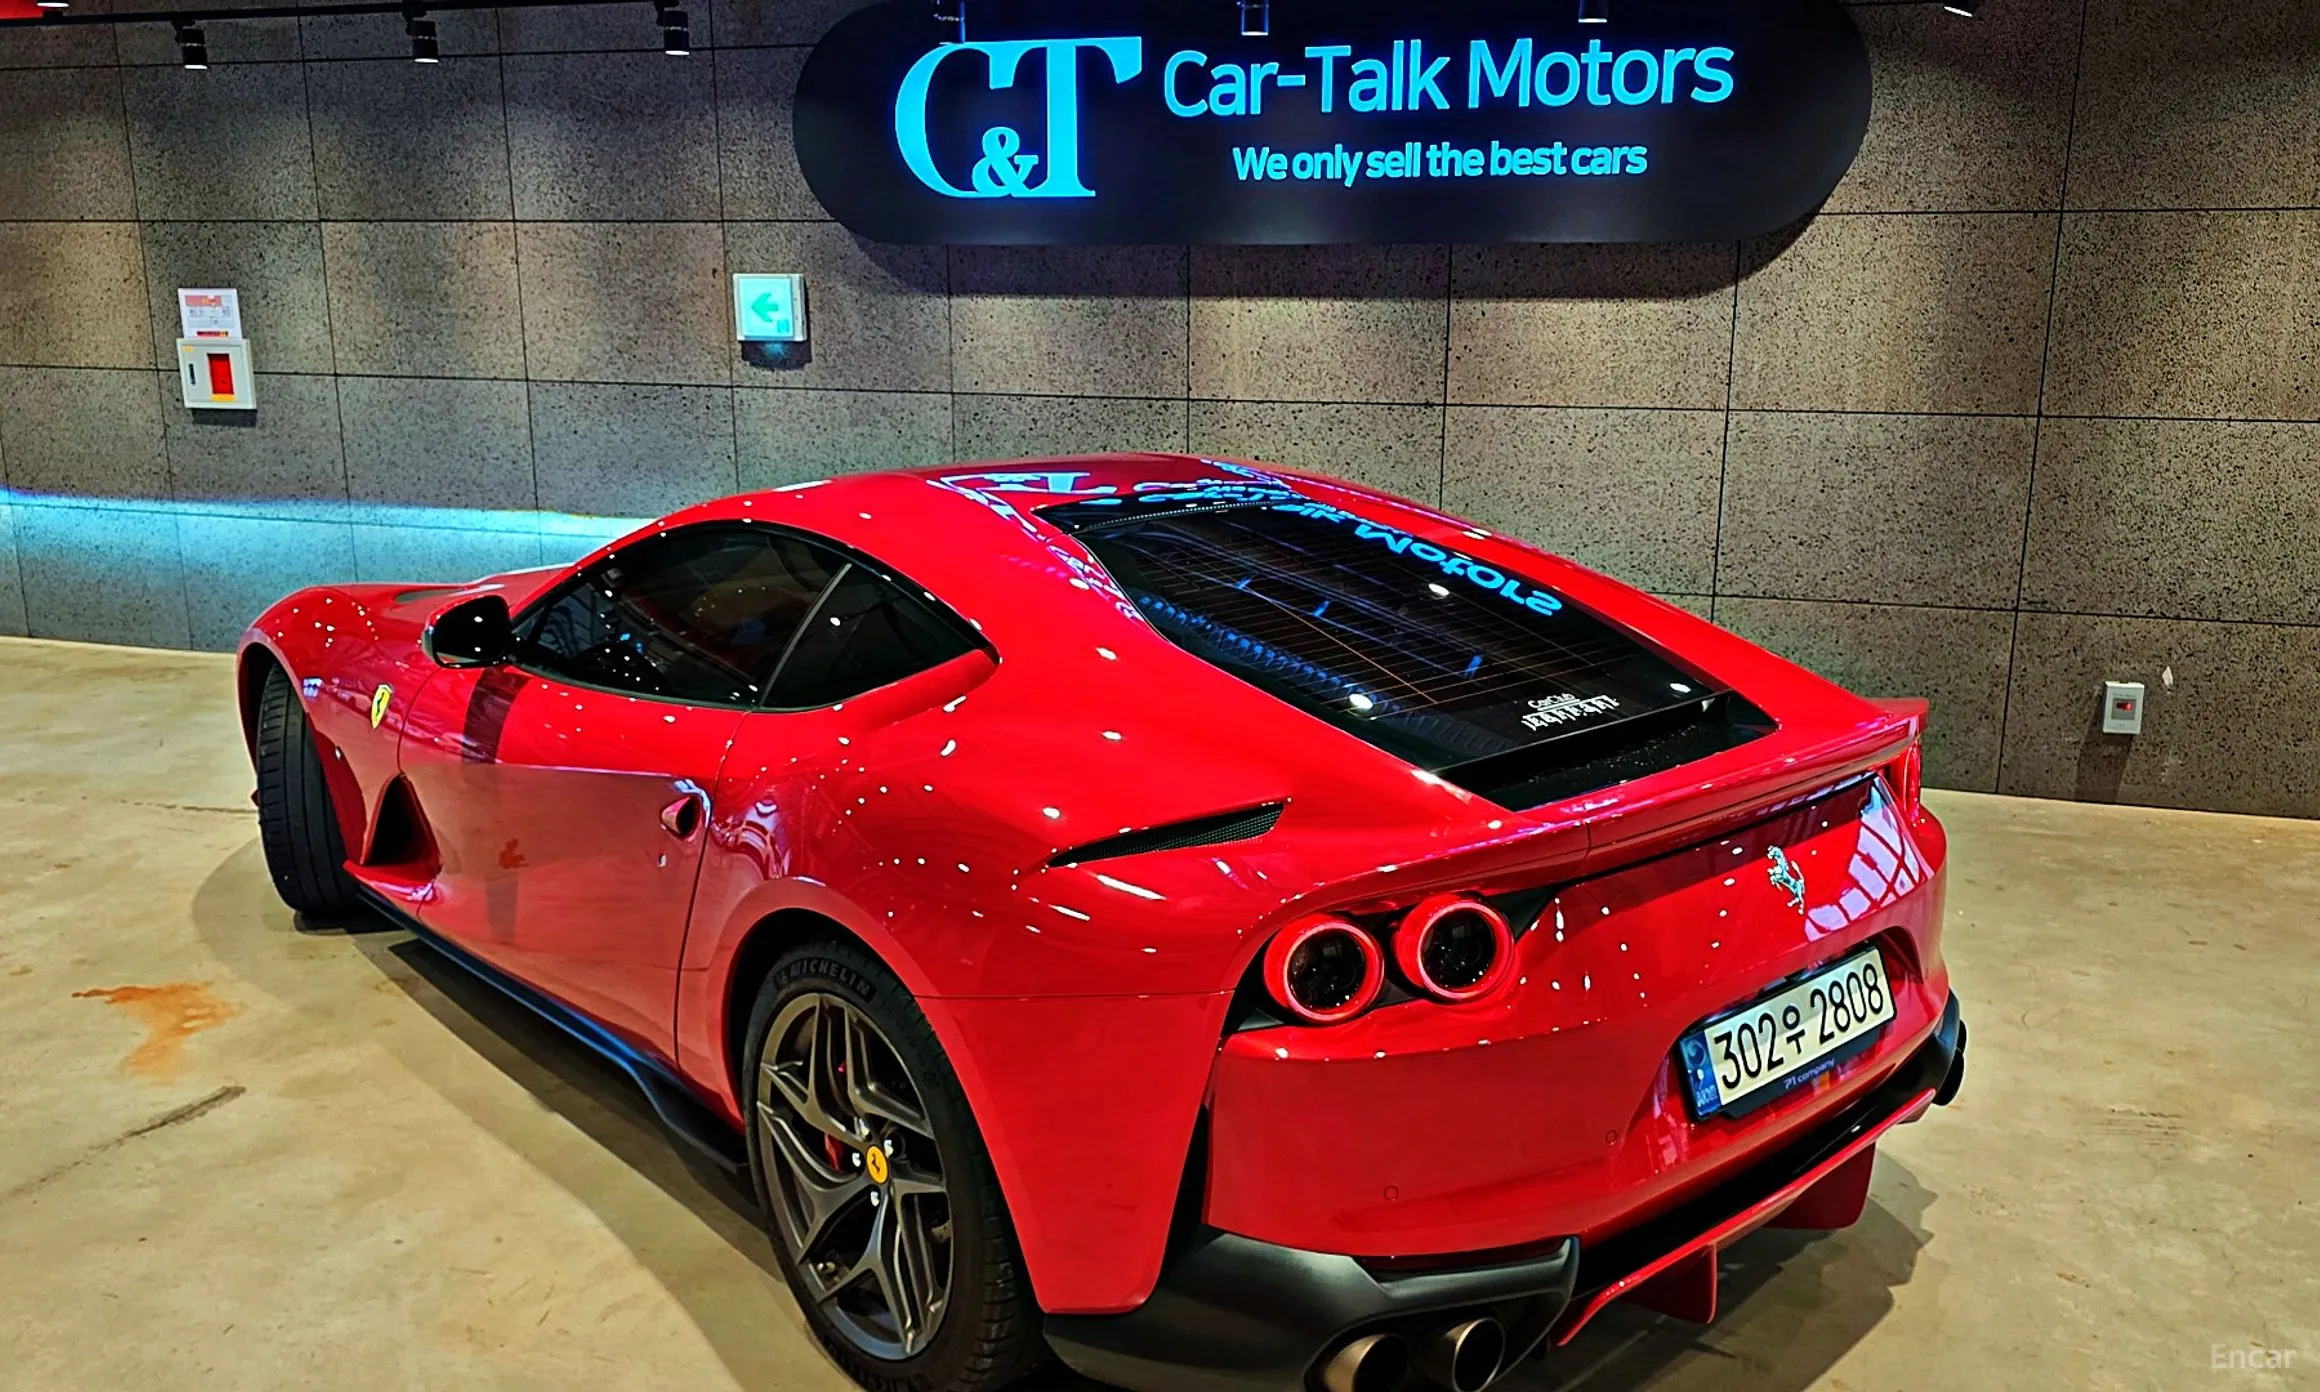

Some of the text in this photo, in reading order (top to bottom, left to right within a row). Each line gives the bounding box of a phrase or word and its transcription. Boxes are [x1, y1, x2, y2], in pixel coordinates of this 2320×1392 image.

[1163, 37, 1735, 118] Car-Talk Motors
[1232, 140, 1648, 188] We only sell the best cars
[789, 958, 872, 996] MICHELIN
[1713, 962, 1884, 1089] 302우 2808
[1796, 1057, 1836, 1084] company
